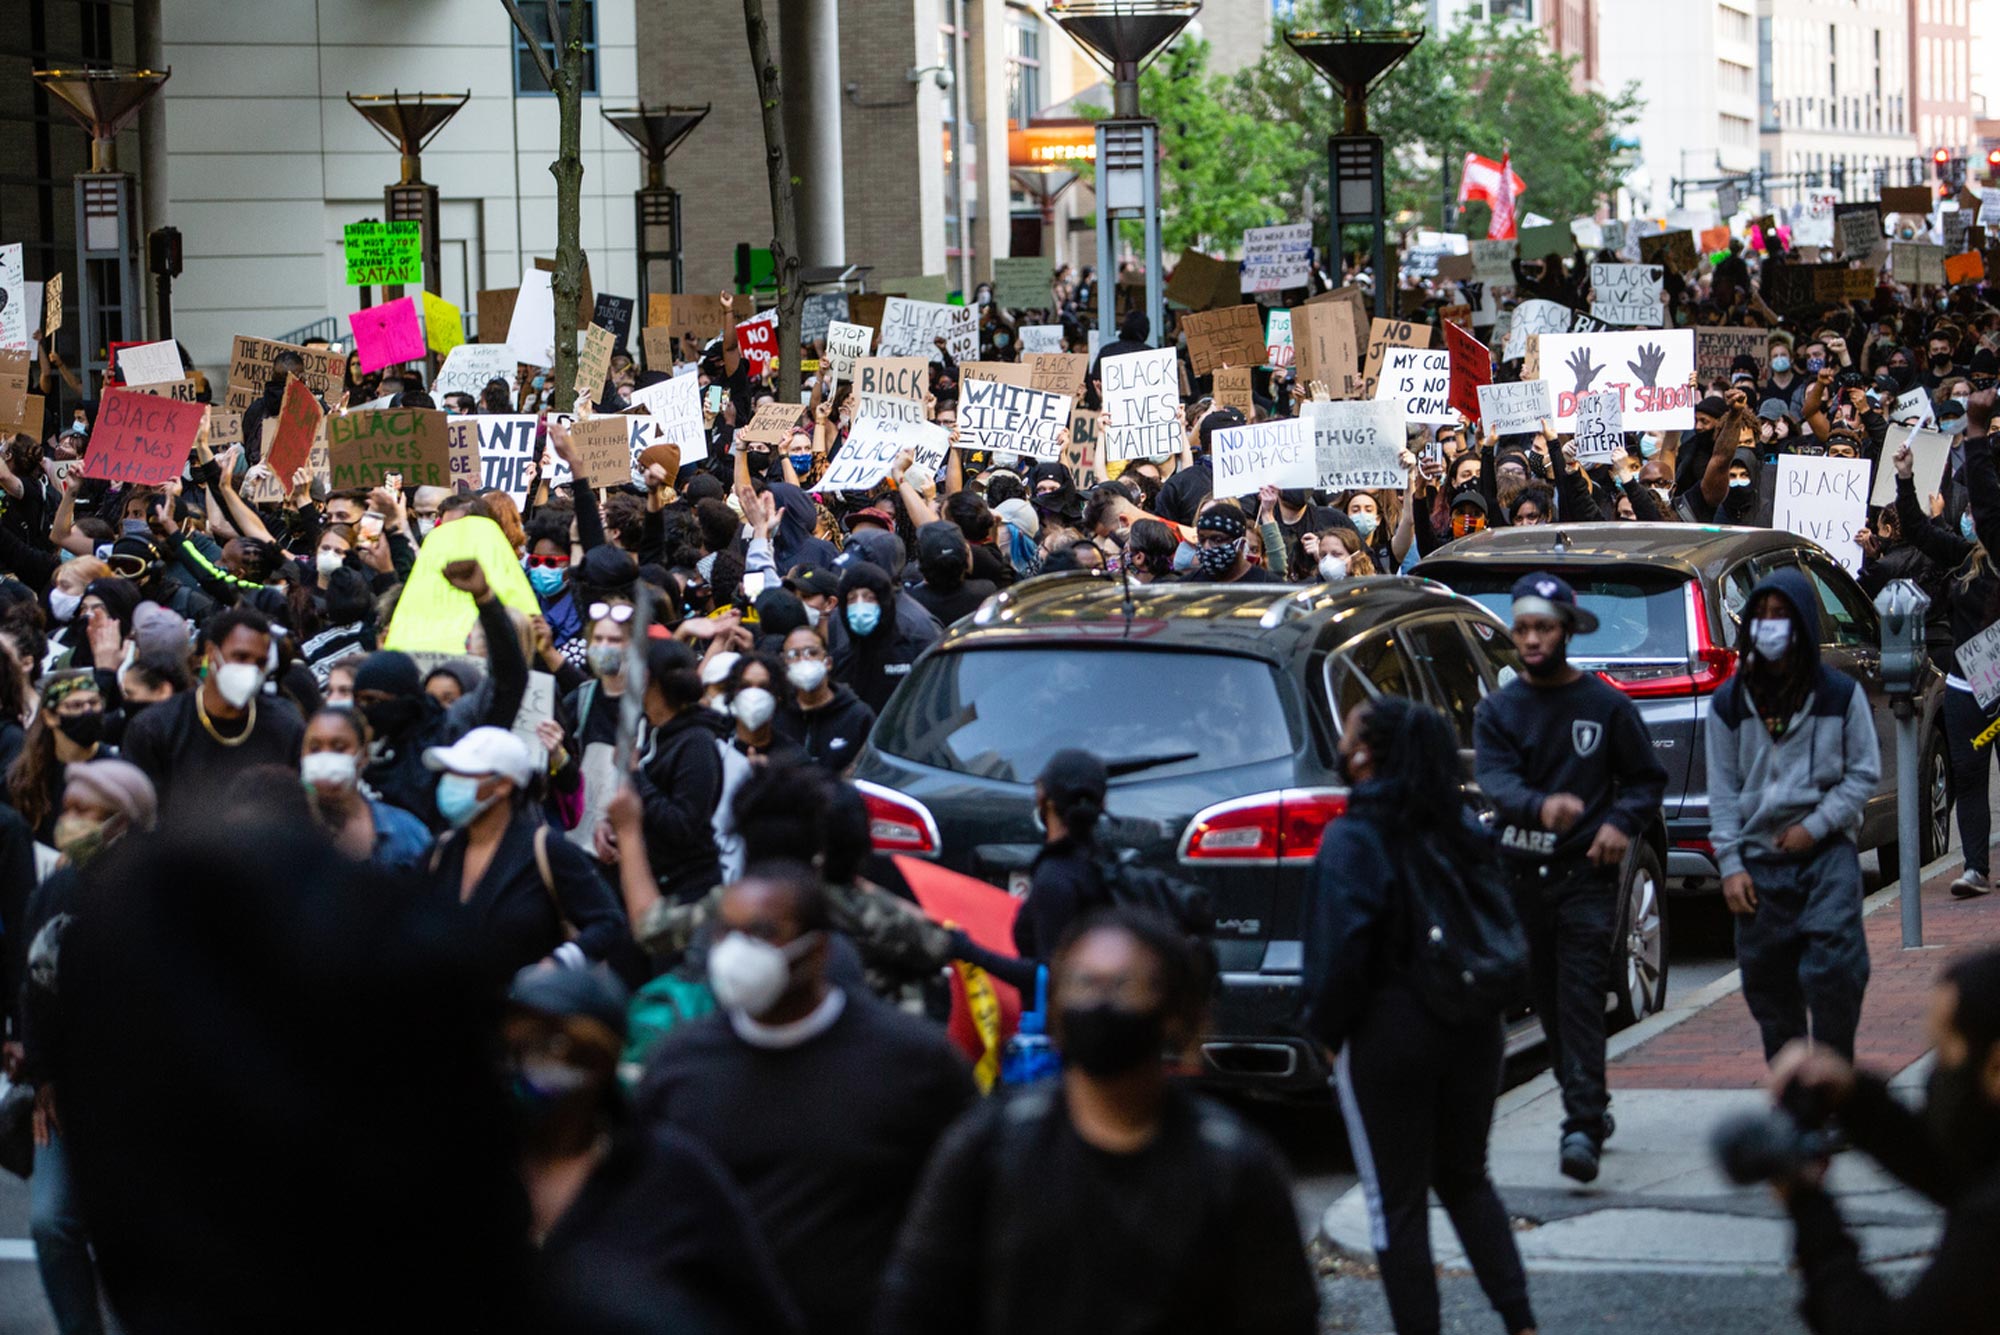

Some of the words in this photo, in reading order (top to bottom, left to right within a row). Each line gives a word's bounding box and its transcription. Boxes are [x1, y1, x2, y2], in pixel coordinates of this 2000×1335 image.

[364, 238, 385, 247] MUST
[391, 238, 416, 247] STOP
[362, 248, 394, 257] THESE
[348, 256, 394, 268] SERVANTS
[1593, 265, 1652, 287] BLACK
[1596, 288, 1655, 307] LIVES
[598, 304, 628, 322] JUSTICE
[952, 307, 971, 325] NO
[1594, 305, 1662, 325] MATTER
[746, 326, 769, 344] NO
[833, 326, 866, 342] STOP
[1283, 334, 1292, 345] 4
[1383, 321, 1412, 341] NO
[953, 337, 971, 354] NO
[240, 340, 259, 360] THE
[315, 355, 327, 374] IS
[1036, 357, 1076, 372] BLACK
[1393, 354, 1418, 370] MY
[1032, 375, 1069, 391] LIVES
[1106, 357, 1178, 392] BLACK
[1218, 375, 1247, 388] BLACK
[171, 383, 195, 401] ARE
[654, 380, 698, 408] BLACK
[1400, 377, 1414, 392] IS
[1424, 377, 1450, 393] NO
[1480, 385, 1520, 402] FUCK
[965, 379, 1061, 421] WHITE
[1407, 397, 1453, 415] CRIME
[1634, 383, 1694, 413] SHOOT
[771, 404, 800, 416] CAN'T
[860, 397, 923, 424] JUSTICE
[1107, 393, 1179, 428] LIVES
[332, 409, 428, 444] BLACK
[573, 421, 601, 436] STOP
[751, 417, 795, 431] BREATHE
[877, 420, 900, 433] FOR
[961, 405, 1066, 441] SILENCE
[587, 435, 628, 447] KILLING
[978, 431, 1061, 457] VIOLENCE
[1105, 421, 1183, 460] MATTER
[1220, 429, 1244, 453] NO
[1247, 420, 1305, 450] JUSTICE
[359, 440, 423, 461] LIVES
[592, 460, 623, 470] PEOPLE
[1220, 453, 1245, 478] NO
[333, 462, 442, 489] MATTER
[481, 455, 533, 494] THE
[1317, 470, 1402, 488] ACIALIZED.
[1788, 469, 1862, 503] BLACK
[1786, 509, 1852, 543] LIVES
[1501, 824, 1558, 854] RARE
